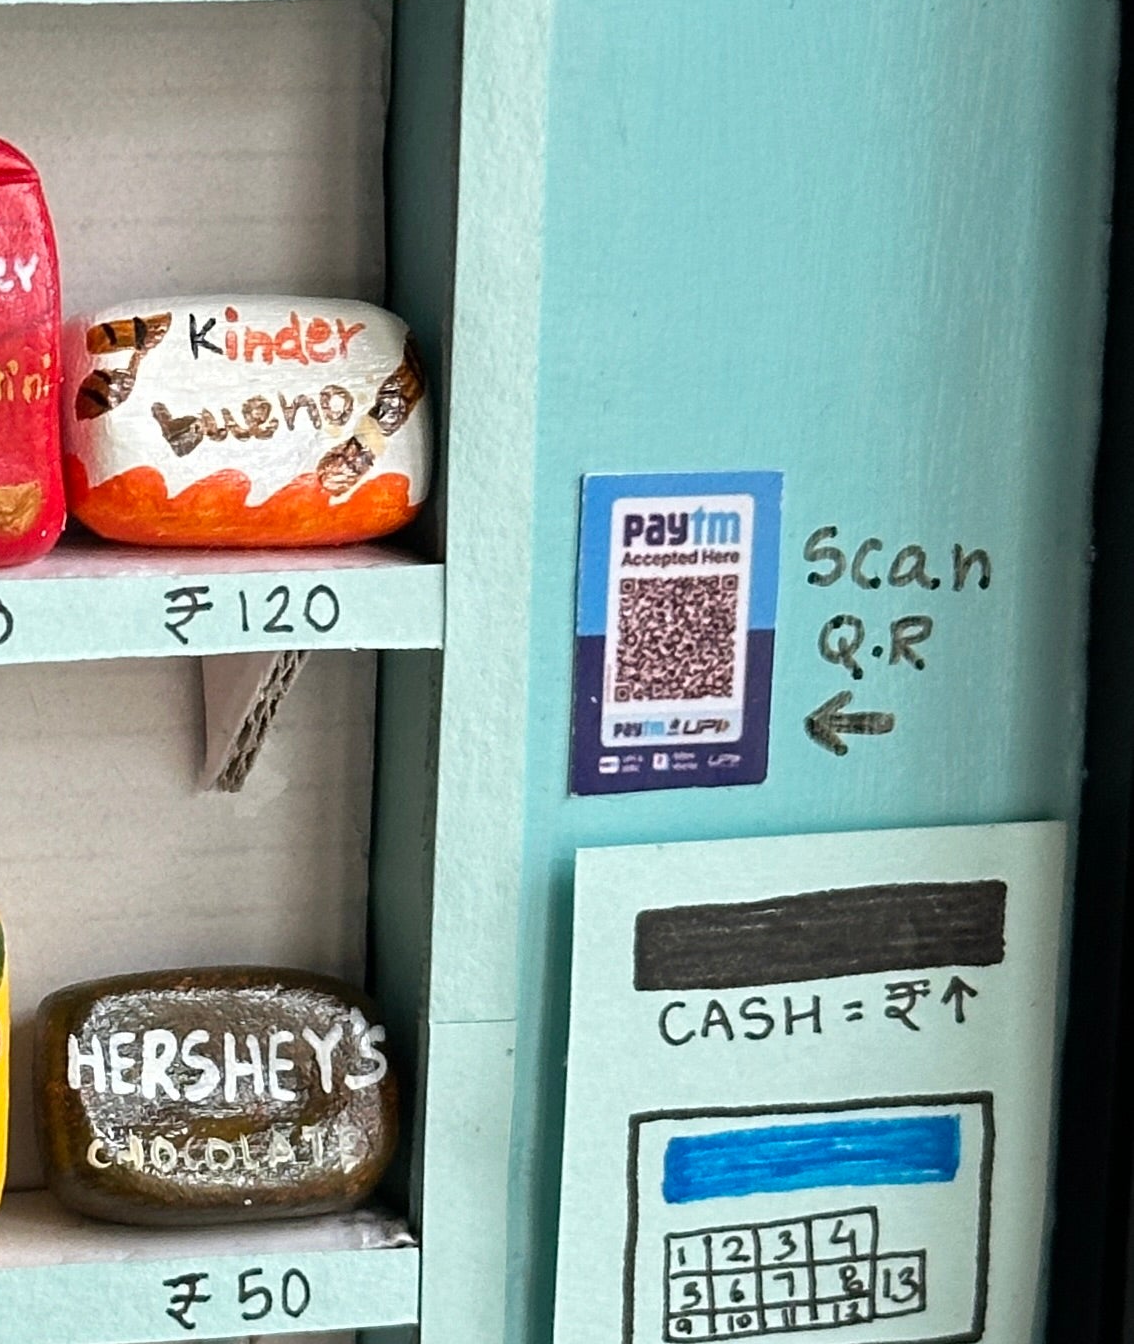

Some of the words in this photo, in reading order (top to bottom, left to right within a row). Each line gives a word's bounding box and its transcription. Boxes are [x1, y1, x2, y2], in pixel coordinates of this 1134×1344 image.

[621, 549, 699, 568] Accepted
[701, 548, 741, 564] Here
[657, 996, 823, 1046] CASH
[677, 1245, 686, 1267] 1
[722, 1235, 751, 1262] 2
[773, 1229, 798, 1261] 3
[829, 1219, 857, 1258] 4
[680, 1281, 703, 1310] 5
[729, 1278, 746, 1303] 6
[772, 1270, 795, 1298] 7
[882, 1266, 920, 1303] 13
[675, 1318, 693, 1335] 9
[727, 1313, 752, 1333] 10
